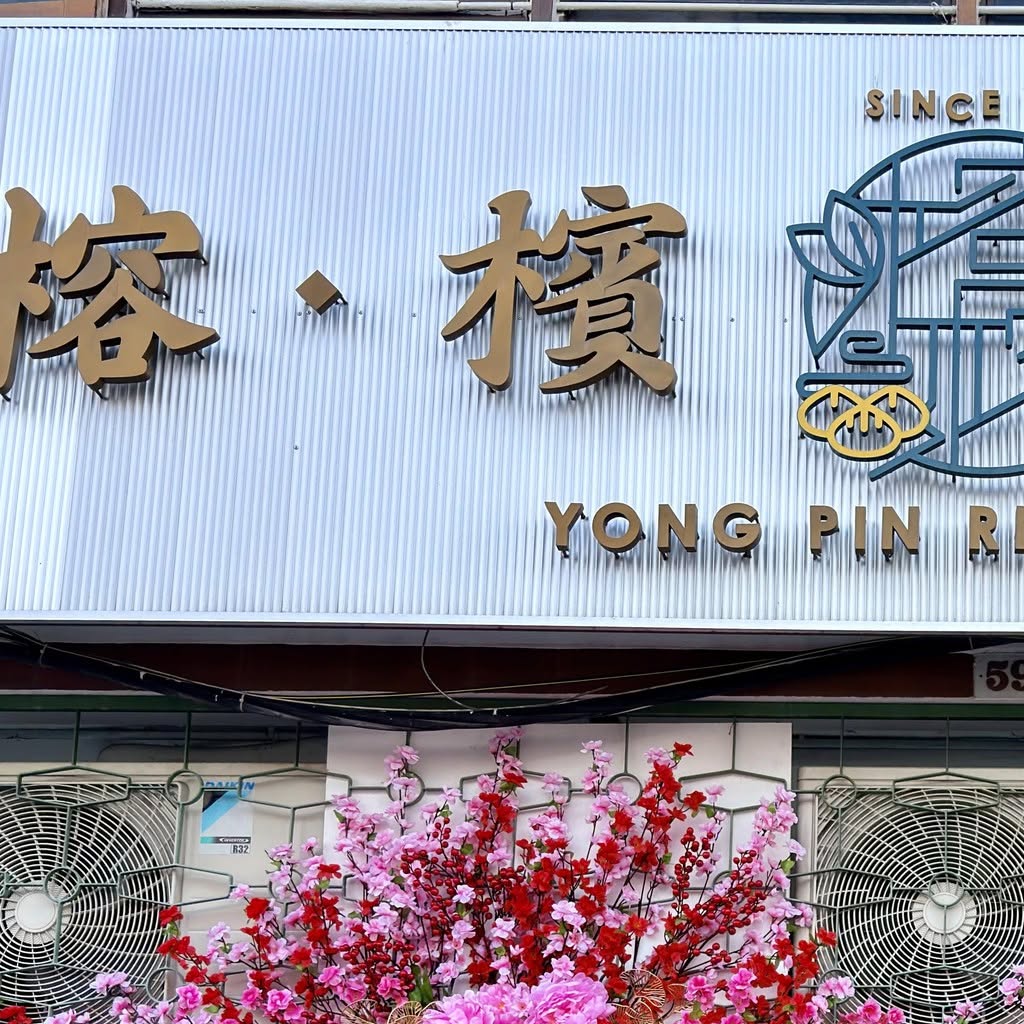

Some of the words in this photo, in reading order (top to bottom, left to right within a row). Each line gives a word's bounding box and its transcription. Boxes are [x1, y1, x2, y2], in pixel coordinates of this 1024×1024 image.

[866, 89, 999, 121] SINCE
[438, 185, 687, 397] 檳
[545, 501, 762, 553] YONG
[810, 505, 920, 556] PIN
[232, 844, 249, 854] R32
